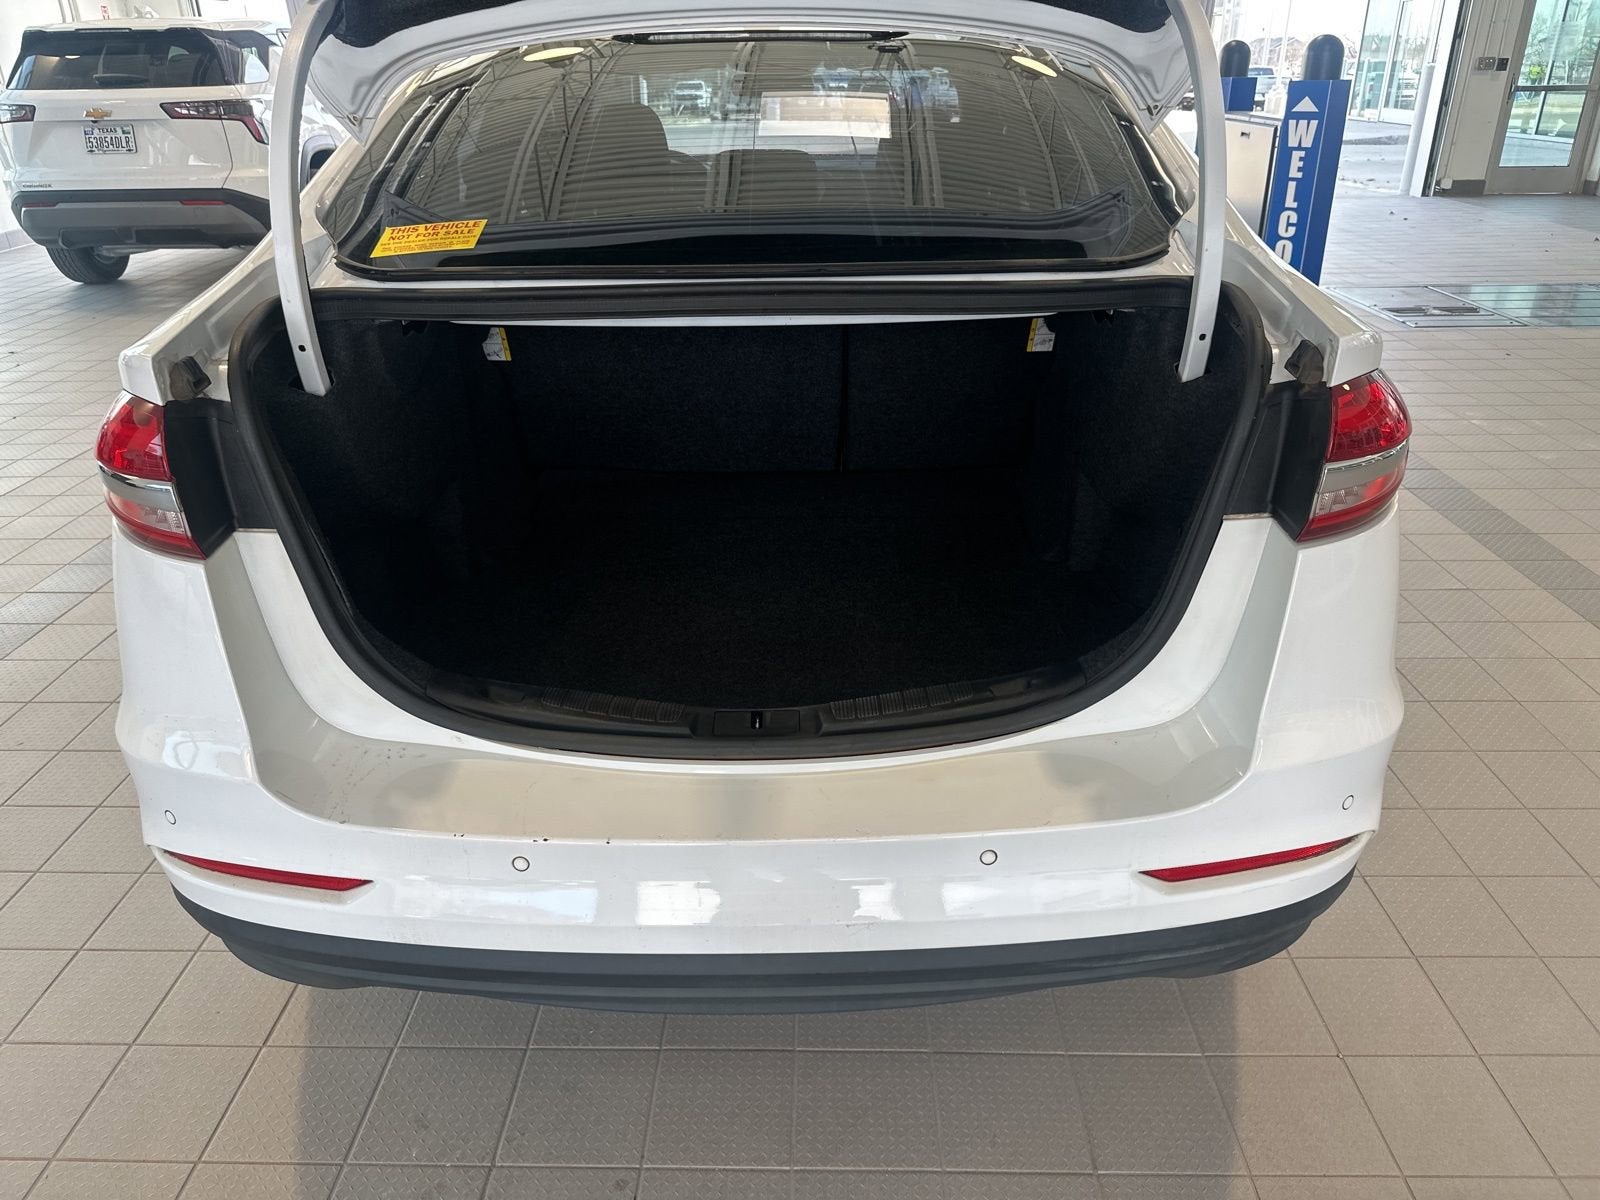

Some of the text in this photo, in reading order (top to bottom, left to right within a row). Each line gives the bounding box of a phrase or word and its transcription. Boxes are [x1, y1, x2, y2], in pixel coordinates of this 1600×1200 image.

[88, 136, 131, 149] 53854DLR
[387, 228, 475, 242] NOT FOR SALE
[389, 220, 482, 236] THIS VEHICLE
